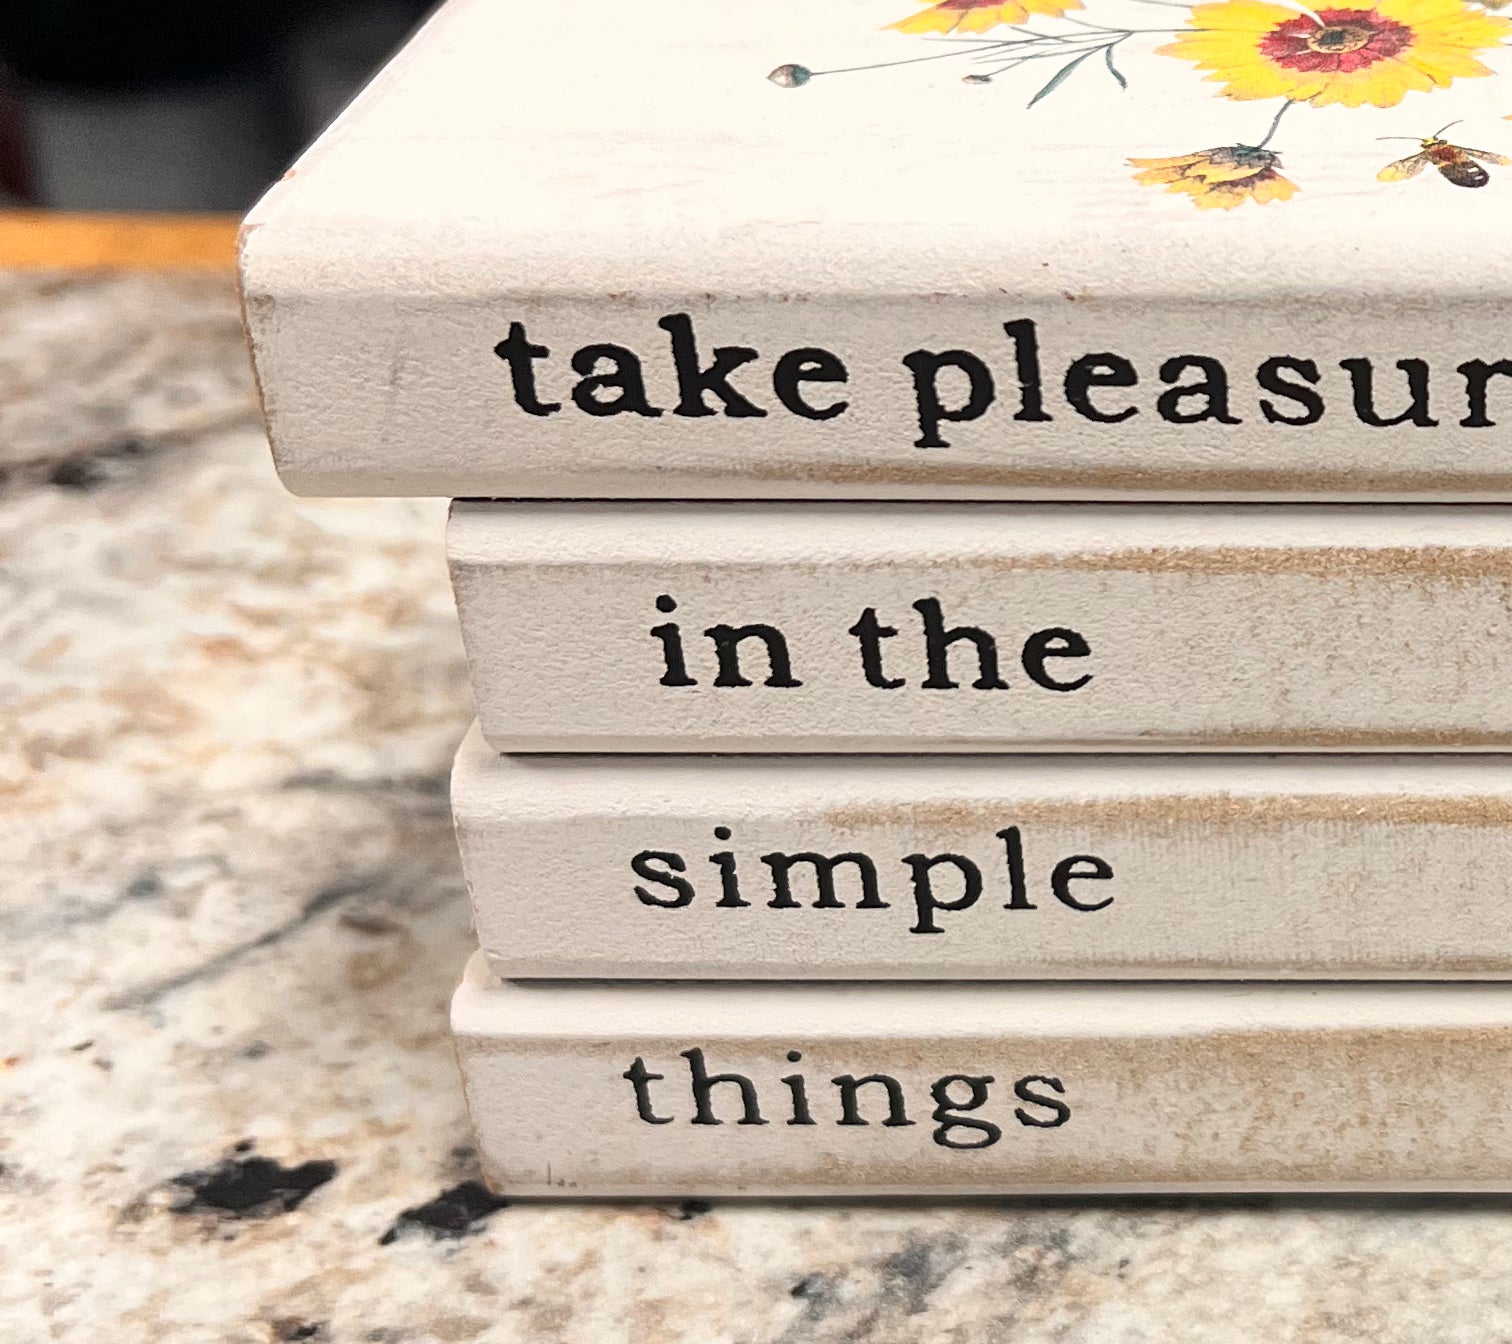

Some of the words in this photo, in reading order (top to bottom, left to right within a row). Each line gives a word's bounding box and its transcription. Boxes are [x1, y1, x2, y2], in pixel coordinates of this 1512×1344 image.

[493, 312, 849, 421] take
[650, 594, 803, 689] in
[848, 596, 1094, 693] the
[630, 825, 1114, 934] simple
[622, 1047, 1071, 1150] things
